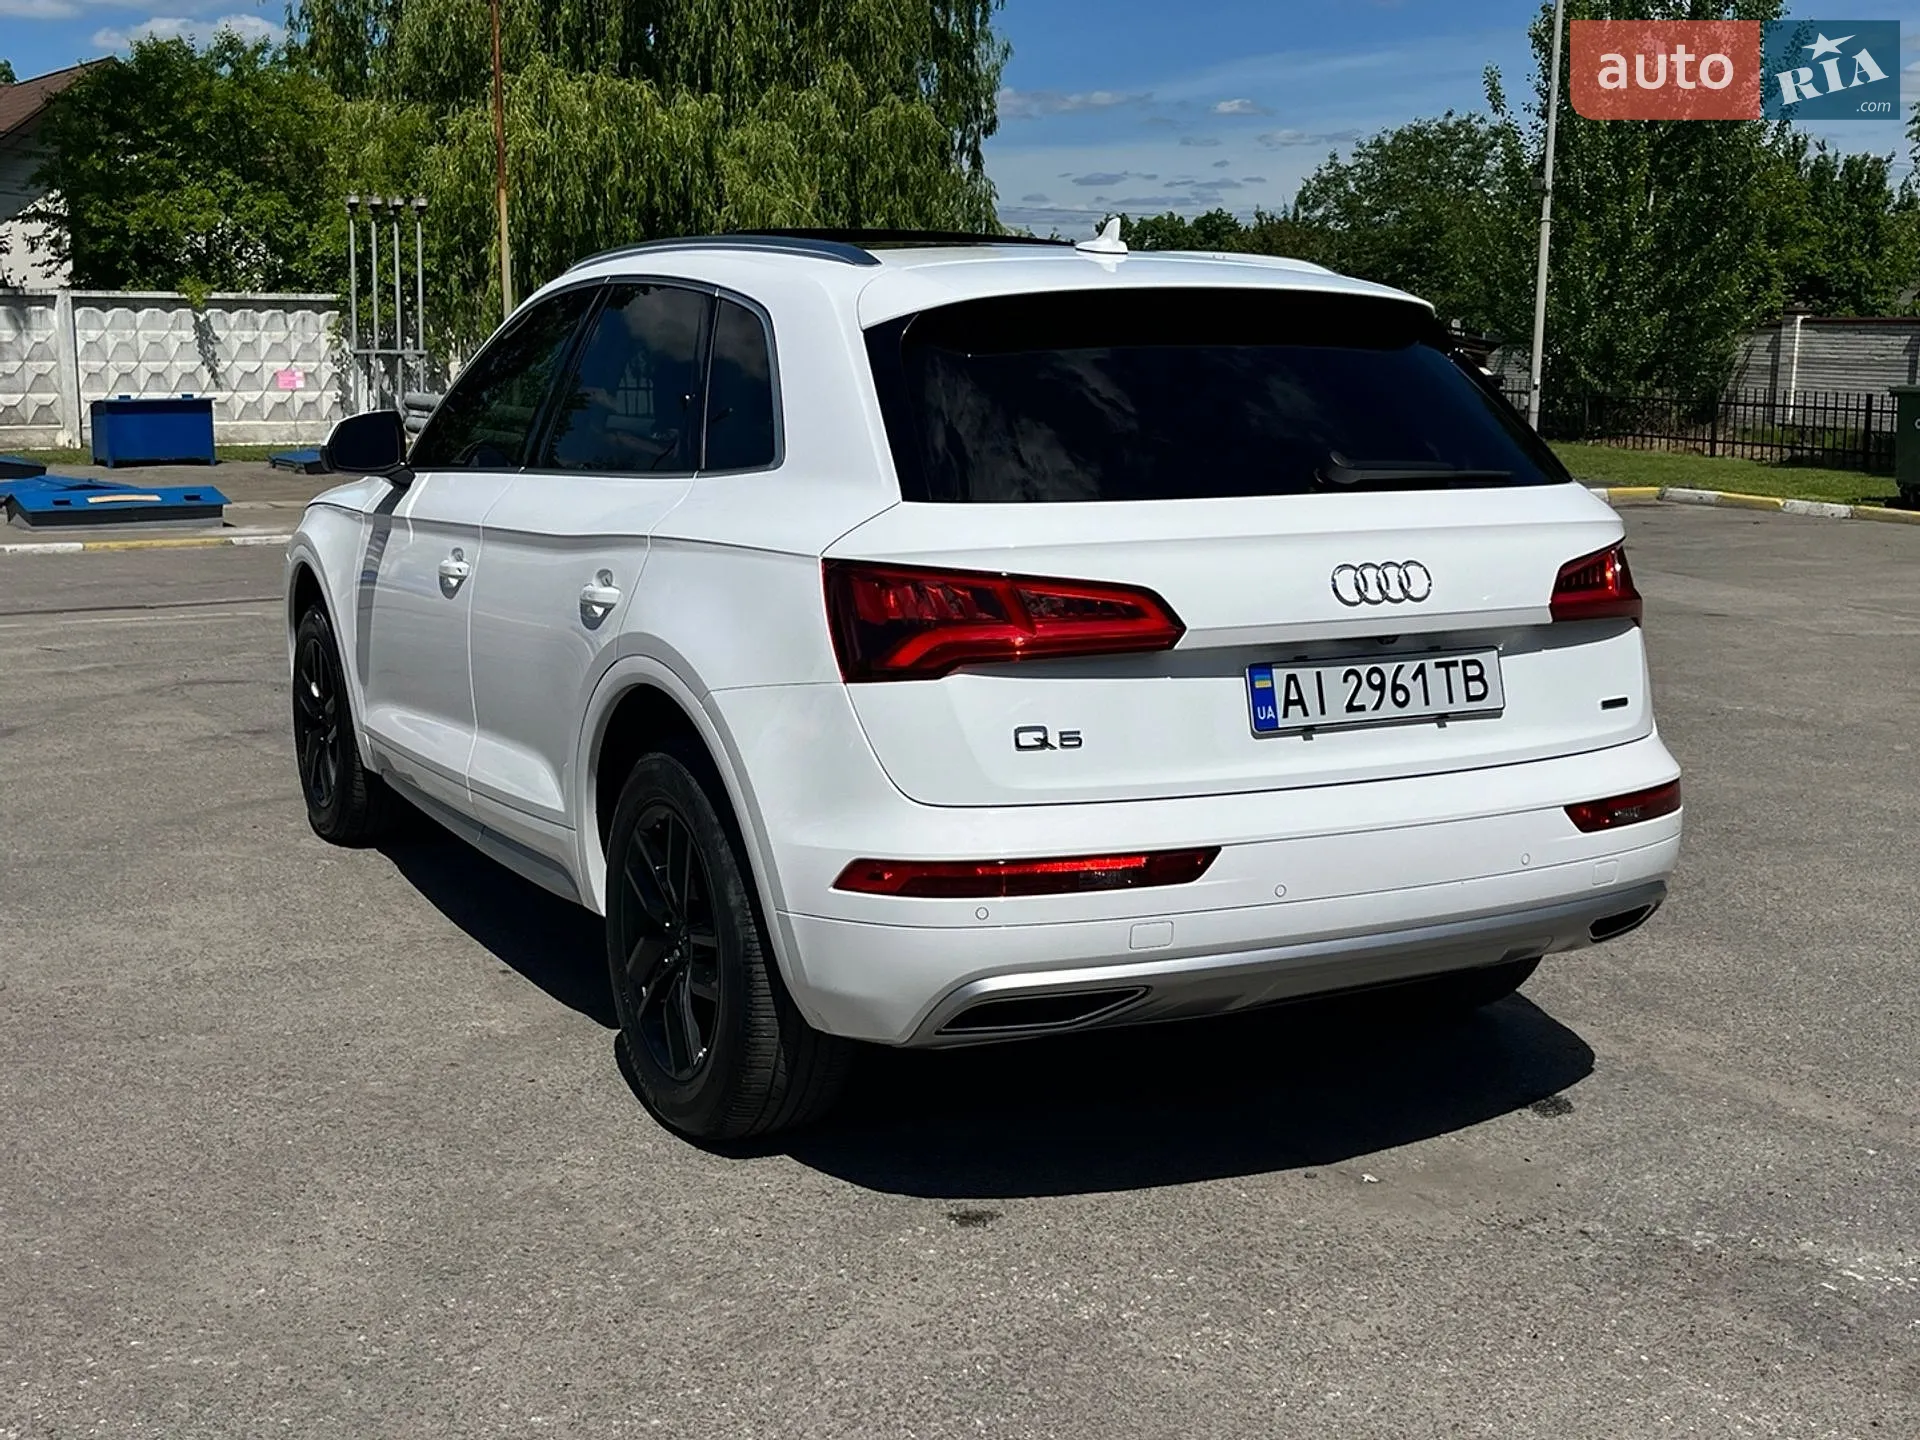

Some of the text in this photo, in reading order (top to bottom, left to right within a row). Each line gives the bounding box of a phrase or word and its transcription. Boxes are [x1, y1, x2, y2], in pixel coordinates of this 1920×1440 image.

[1282, 670, 1327, 719] AI
[1257, 706, 1276, 720] UA
[1014, 725, 1083, 751] Q5
